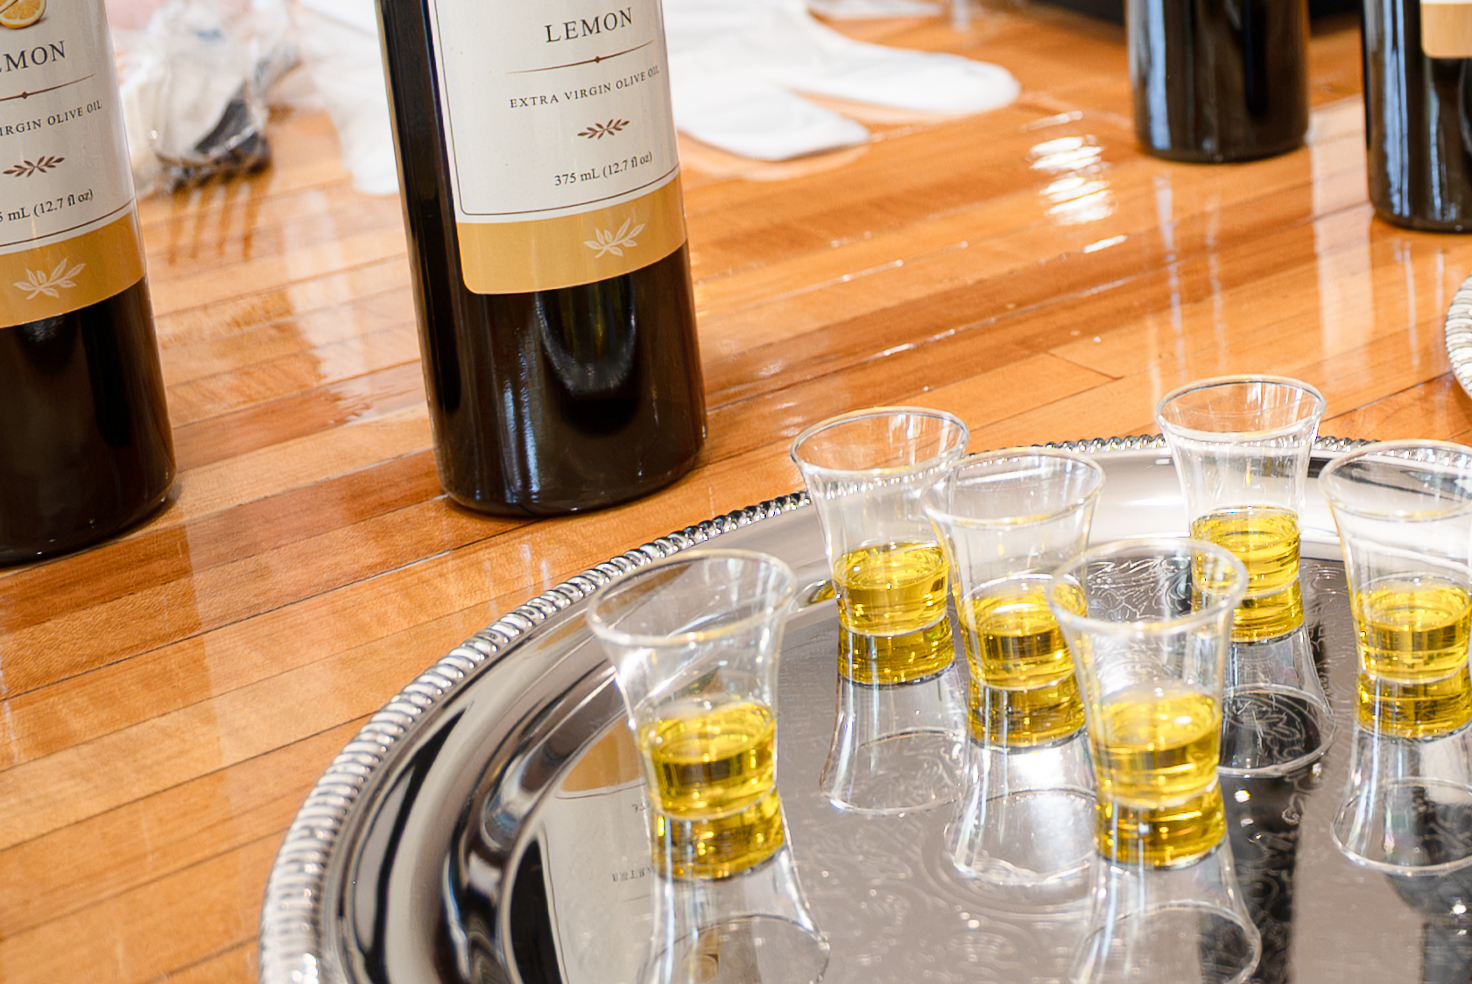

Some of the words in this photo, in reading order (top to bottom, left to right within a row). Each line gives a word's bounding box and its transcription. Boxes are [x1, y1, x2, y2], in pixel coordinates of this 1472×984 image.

[544, 7, 634, 44] LEMON
[0, 40, 67, 73] MON
[510, 94, 560, 108] EXTRA
[564, 82, 612, 101] VIRGIN
[615, 71, 646, 90] OLIVE
[647, 65, 660, 78] OIL
[0, 119, 42, 137] IRGIN
[47, 107, 84, 126] OLIVE
[86, 99, 102, 114] OIL
[554, 172, 577, 187] 375
[580, 168, 600, 182] mL
[602, 159, 628, 179] (12.7
[629, 156, 638, 170] fl
[640, 151, 653, 165] oz)
[8, 207, 31, 222] mL
[33, 197, 64, 217] (12.7
[67, 194, 76, 208] fl
[78, 188, 94, 203] oz)
